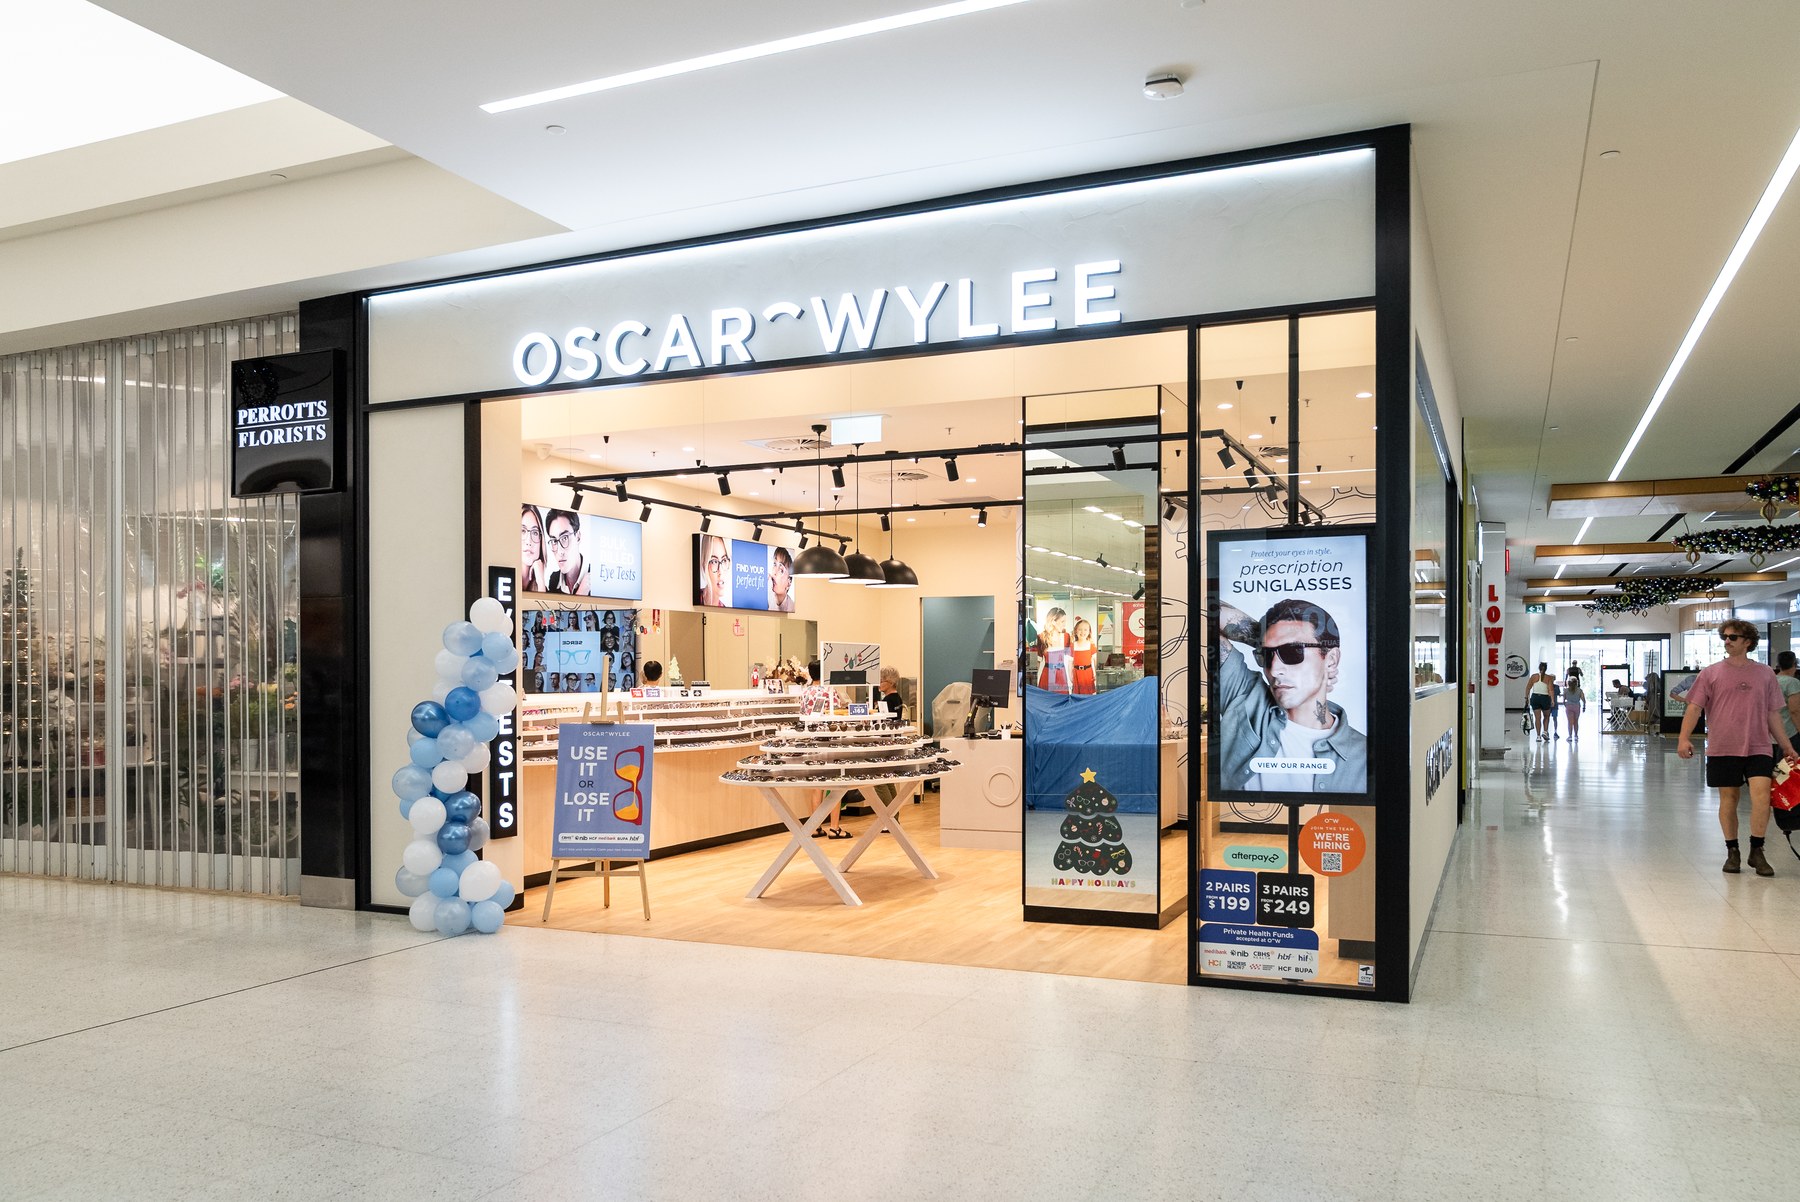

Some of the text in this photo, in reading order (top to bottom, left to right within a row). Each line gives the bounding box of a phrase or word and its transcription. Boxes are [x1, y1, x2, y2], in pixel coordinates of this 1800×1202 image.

[512, 260, 1122, 387] OSCAR WYLEE
[237, 400, 328, 426] PERROTTS
[238, 423, 327, 448] FLORISTS
[1250, 547, 1332, 558] Protect your eyes in style.
[599, 564, 636, 582] Eye Tests
[736, 563, 765, 575] FIND YOUR
[1239, 559, 1343, 578] prescription
[736, 574, 765, 590] perfect fit
[1232, 577, 1352, 594] SUNGLASSES
[1483, 584, 1504, 687] LOWES
[498, 680, 514, 828] ESTS
[570, 746, 608, 760] USE
[580, 762, 597, 776] IT
[578, 780, 594, 788] OR
[563, 792, 610, 806] LOSE
[577, 808, 594, 822] IT
[1314, 832, 1350, 841] WE'RE
[1313, 841, 1351, 850] HIRING
[1231, 852, 1269, 863] afterpay
[1051, 878, 1136, 888] HAPPY HOLIDAYS
[1205, 881, 1251, 893] 2 PAIRS
[1262, 885, 1309, 897] 3 PAIRS
[1223, 928, 1247, 936] Private
[1272, 931, 1294, 939] Funds
[1298, 954, 1309, 962] hif
[1294, 966, 1313, 974] BUPA
